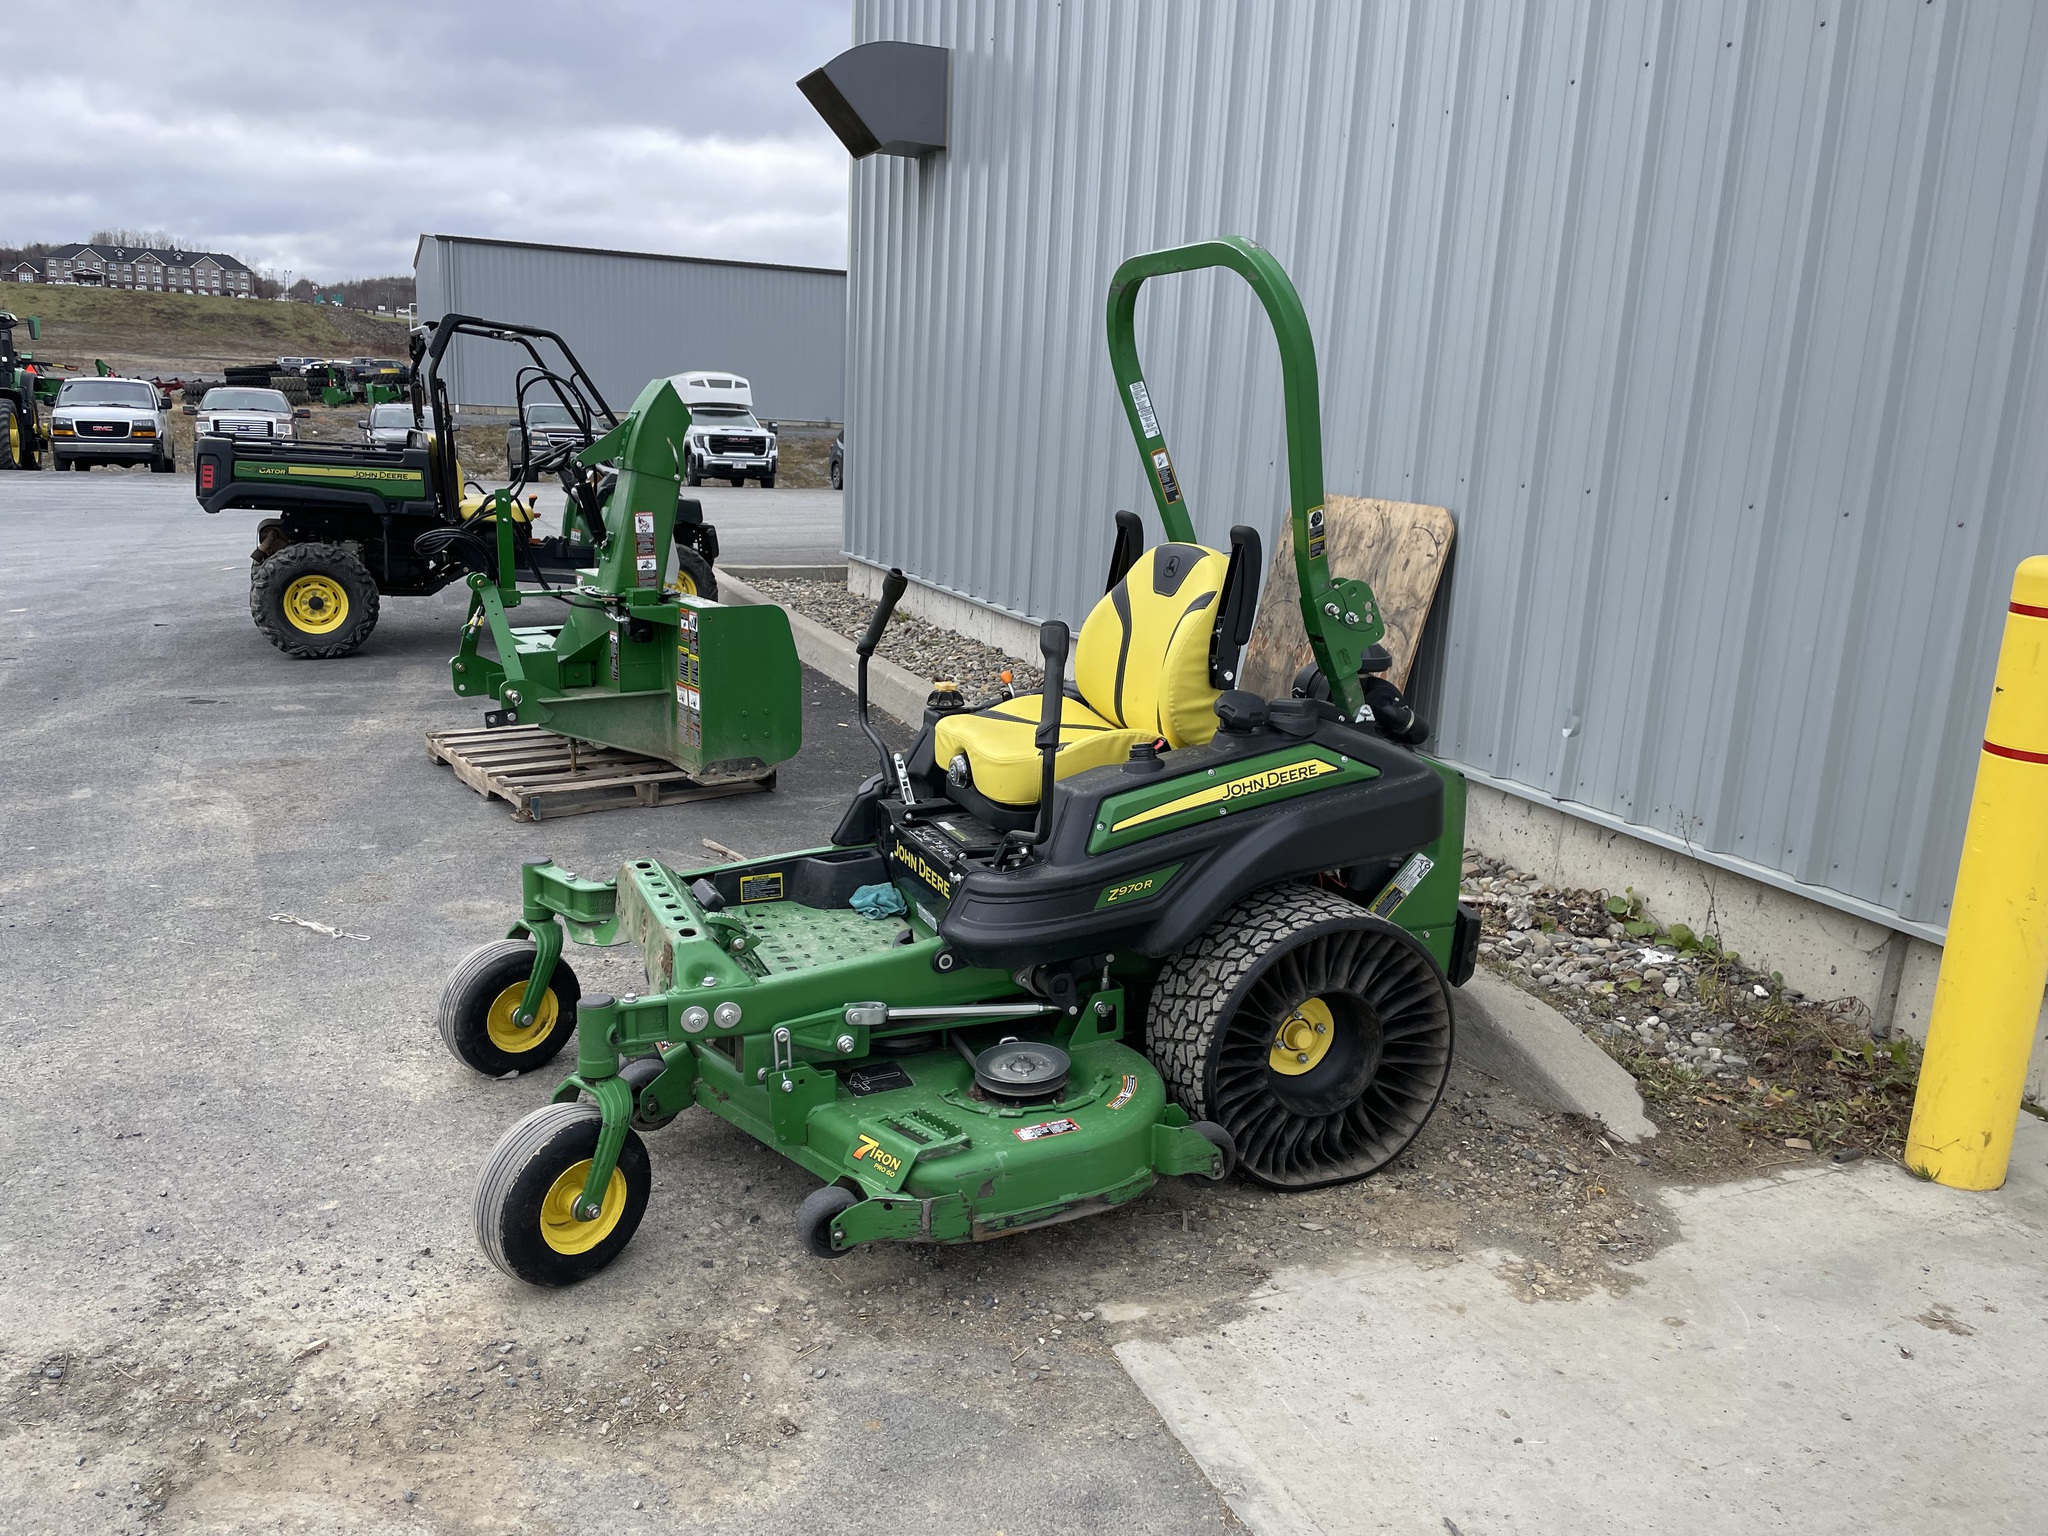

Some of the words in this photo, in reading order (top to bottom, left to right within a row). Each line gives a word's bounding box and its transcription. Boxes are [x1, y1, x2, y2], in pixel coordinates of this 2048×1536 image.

[258, 467, 286, 476] GATOR
[353, 470, 378, 479] JOHN
[379, 471, 409, 480] DEERE
[1222, 777, 1265, 799] JOHN
[1267, 764, 1318, 787] DEERE
[894, 839, 917, 872] JOHN
[918, 857, 951, 900] DEERE
[1107, 879, 1153, 901] Z970R
[869, 1147, 902, 1171] IRON
[873, 1162, 886, 1173] PRO
[885, 1169, 896, 1178] 60
